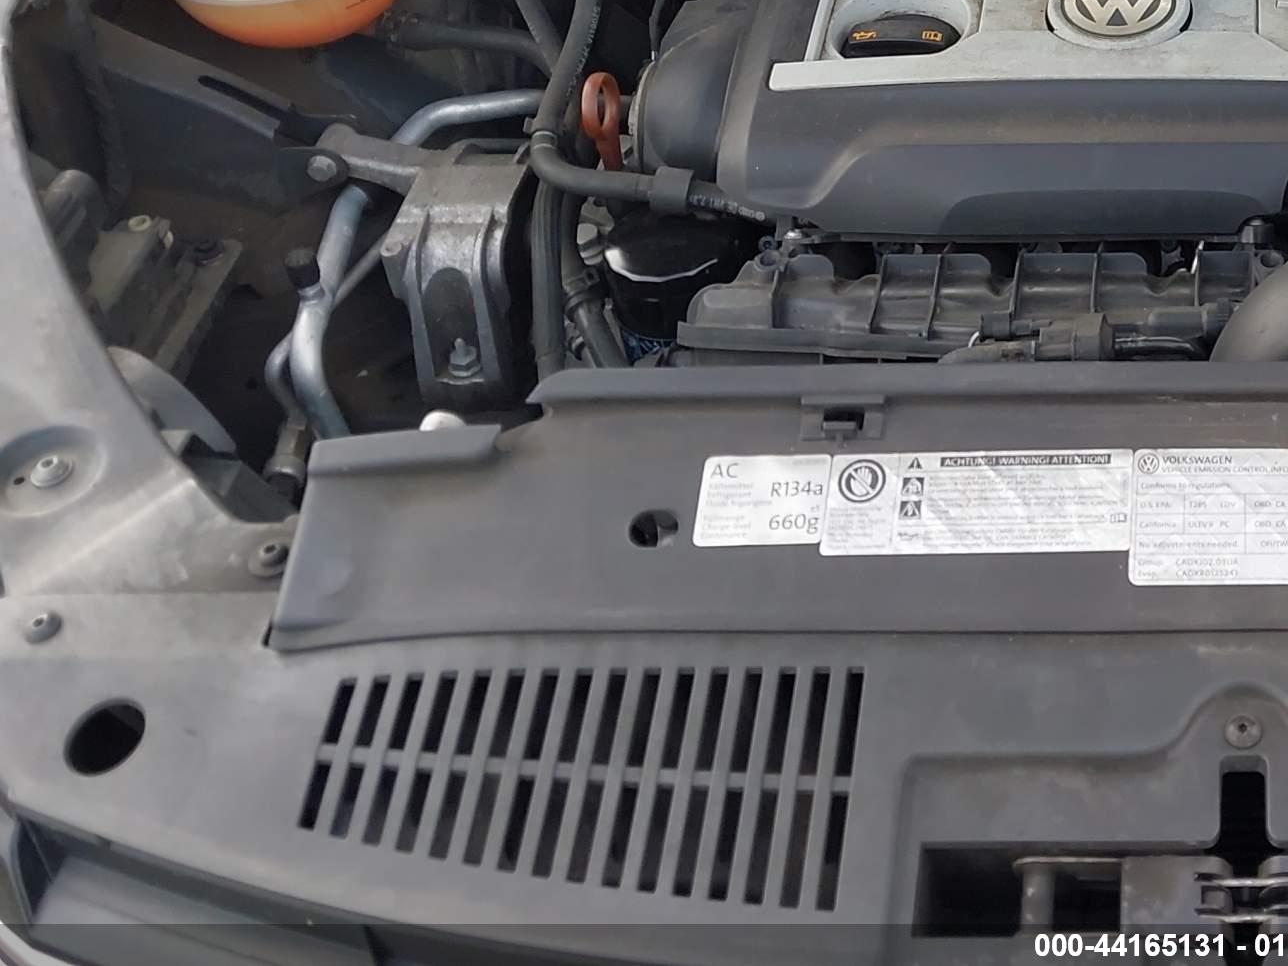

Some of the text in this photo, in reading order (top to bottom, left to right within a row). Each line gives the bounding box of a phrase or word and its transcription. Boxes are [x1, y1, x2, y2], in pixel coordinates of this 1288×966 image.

[944, 455, 1109, 467] ACHTUNG! WARNING! ATTENTION!
[1162, 455, 1233, 464] VOLKSWAGEN
[710, 462, 739, 479] AC
[1162, 465, 1192, 473] VEHICLE
[1194, 465, 1231, 473] EMISSION
[1232, 465, 1269, 473] CONTROL
[770, 481, 824, 497] R134a
[768, 513, 820, 535] 660g
